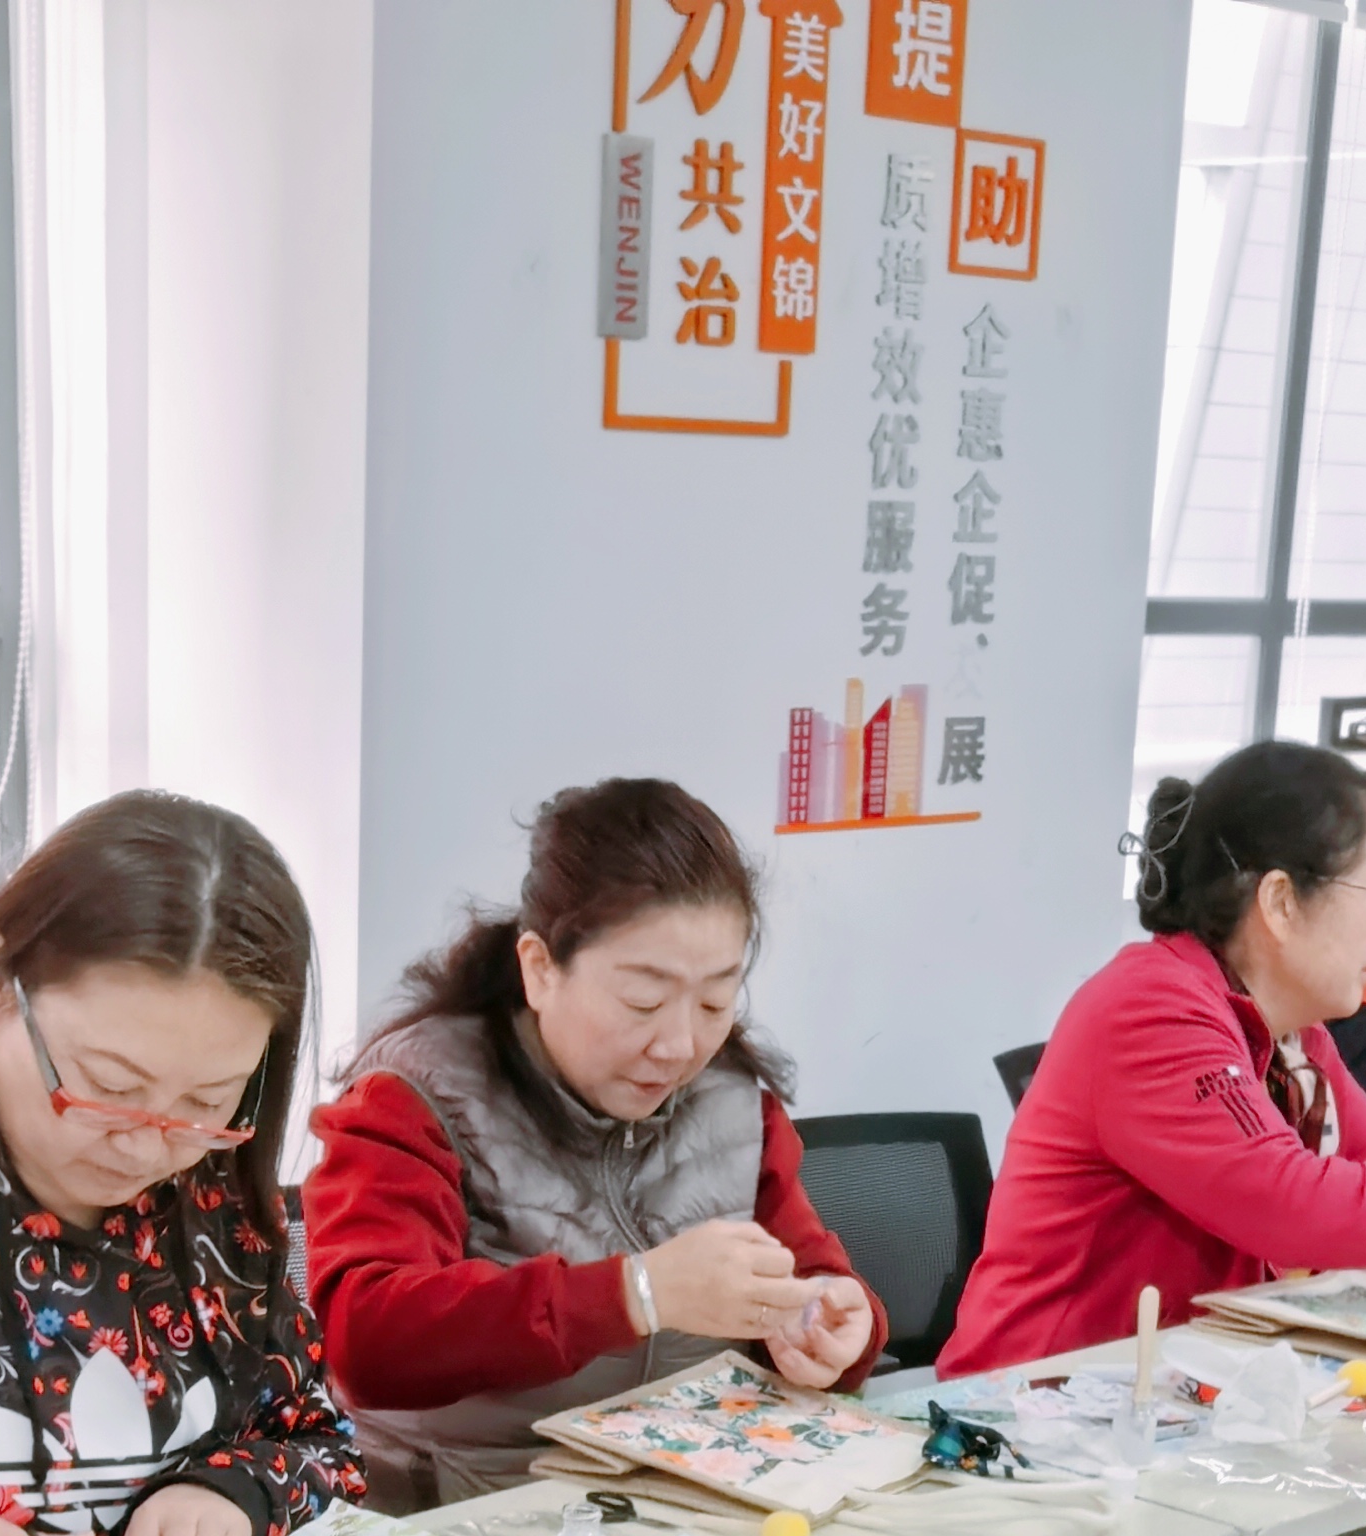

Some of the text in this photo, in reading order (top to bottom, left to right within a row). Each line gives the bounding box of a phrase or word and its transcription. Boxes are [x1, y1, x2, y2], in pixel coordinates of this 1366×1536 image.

[614, 152, 643, 324] WENJIN
[771, 12, 827, 322] 美好文锦
